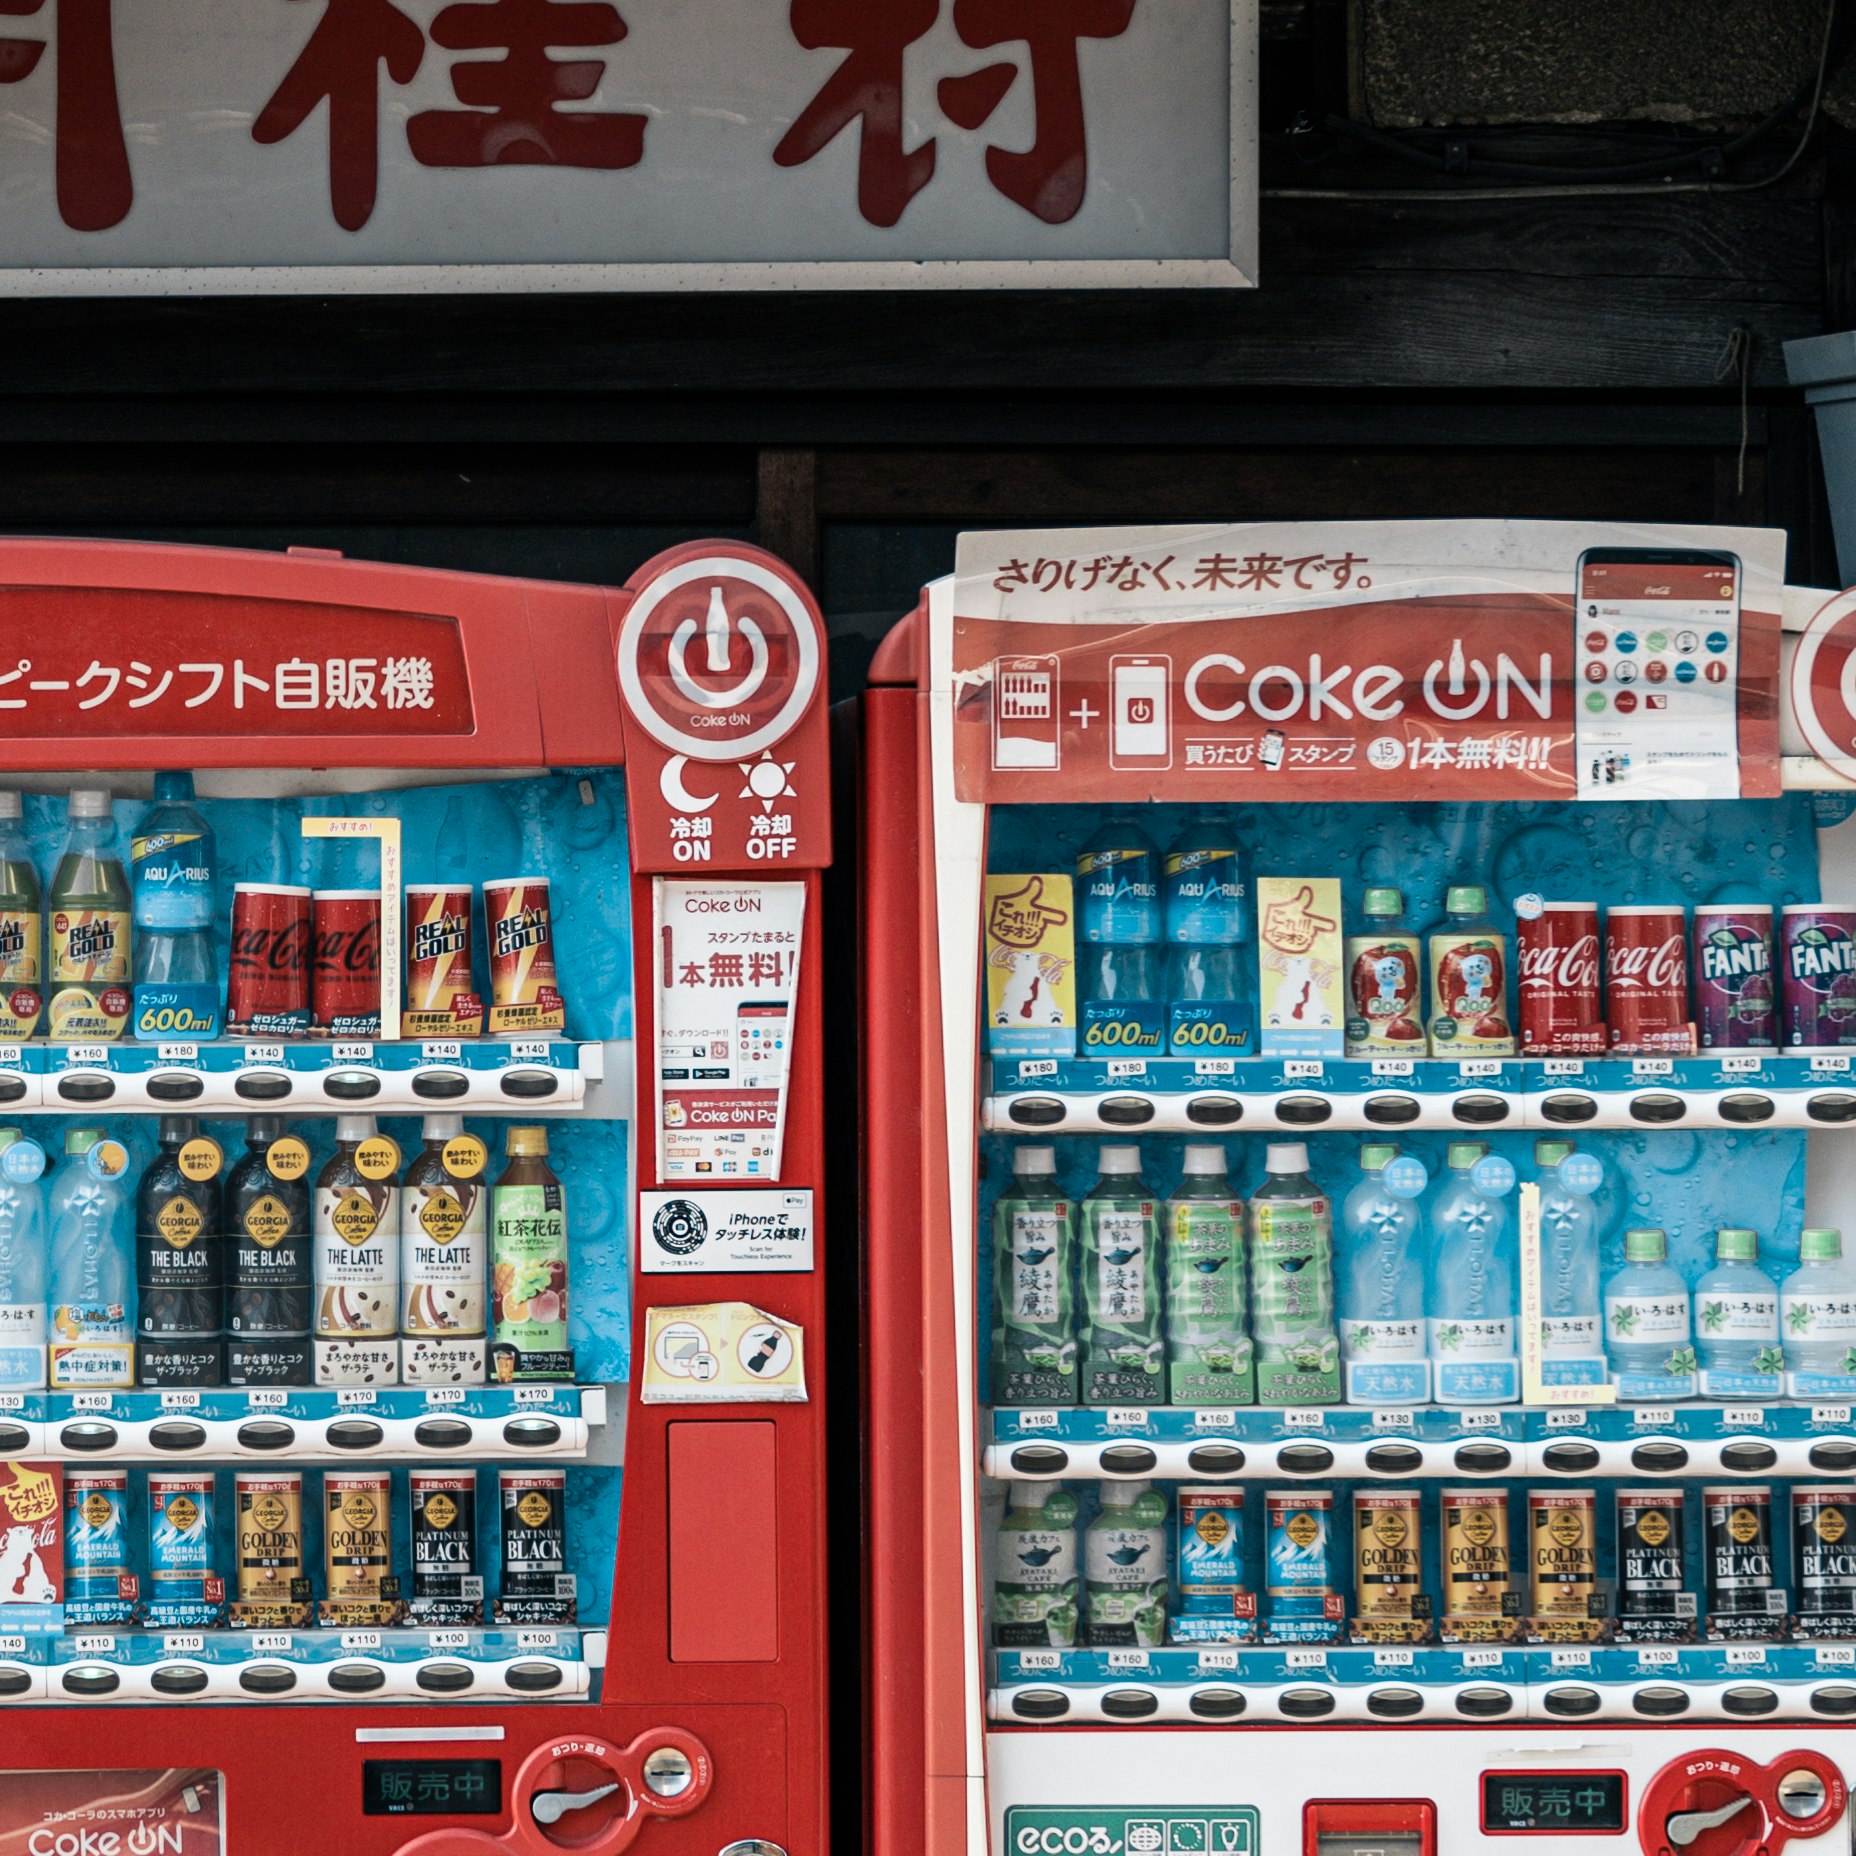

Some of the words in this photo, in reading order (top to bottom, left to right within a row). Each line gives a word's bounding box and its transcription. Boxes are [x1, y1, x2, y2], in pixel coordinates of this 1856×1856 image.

[993, 552, 1373, 596] さりげなく、未来です。
[1184, 652, 1405, 722] Coke
[691, 715, 727, 727] Coke
[1185, 745, 1254, 764] 買うたび
[1288, 744, 1356, 763] スタンプ
[670, 817, 712, 839] 冷却
[750, 815, 791, 835] 冷却
[673, 840, 711, 861] ON
[746, 838, 797, 859] OFF
[685, 899, 731, 913] Coke
[708, 932, 795, 944] スタンプたまると
[140, 993, 178, 1005] たっぷり
[139, 1008, 213, 1033] 600ml
[1086, 1023, 1159, 1046] 600ml
[691, 1110, 730, 1123] Coke
[498, 1219, 561, 1237] 紅茶花伝
[729, 1213, 789, 1226] iPhoneで
[715, 1228, 806, 1241] タッチレス体験!
[151, 1250, 169, 1267] THE
[173, 1249, 208, 1267] BLACK
[327, 1249, 345, 1265] THE
[348, 1248, 382, 1265] LATTE
[145, 1355, 215, 1365] 豊かな香りとコク
[325, 1353, 389, 1362] まろやかな甘さ
[242, 1532, 299, 1551] GOLDEN
[416, 1532, 469, 1543] PLATINUM
[256, 1547, 286, 1557] DRIP
[417, 1542, 470, 1561] BLACK
[381, 1772, 484, 1800] 販売中
[1502, 1788, 1605, 1816] 販売中
[43, 1808, 166, 1821] コカ・コーラのスマホアプリ
